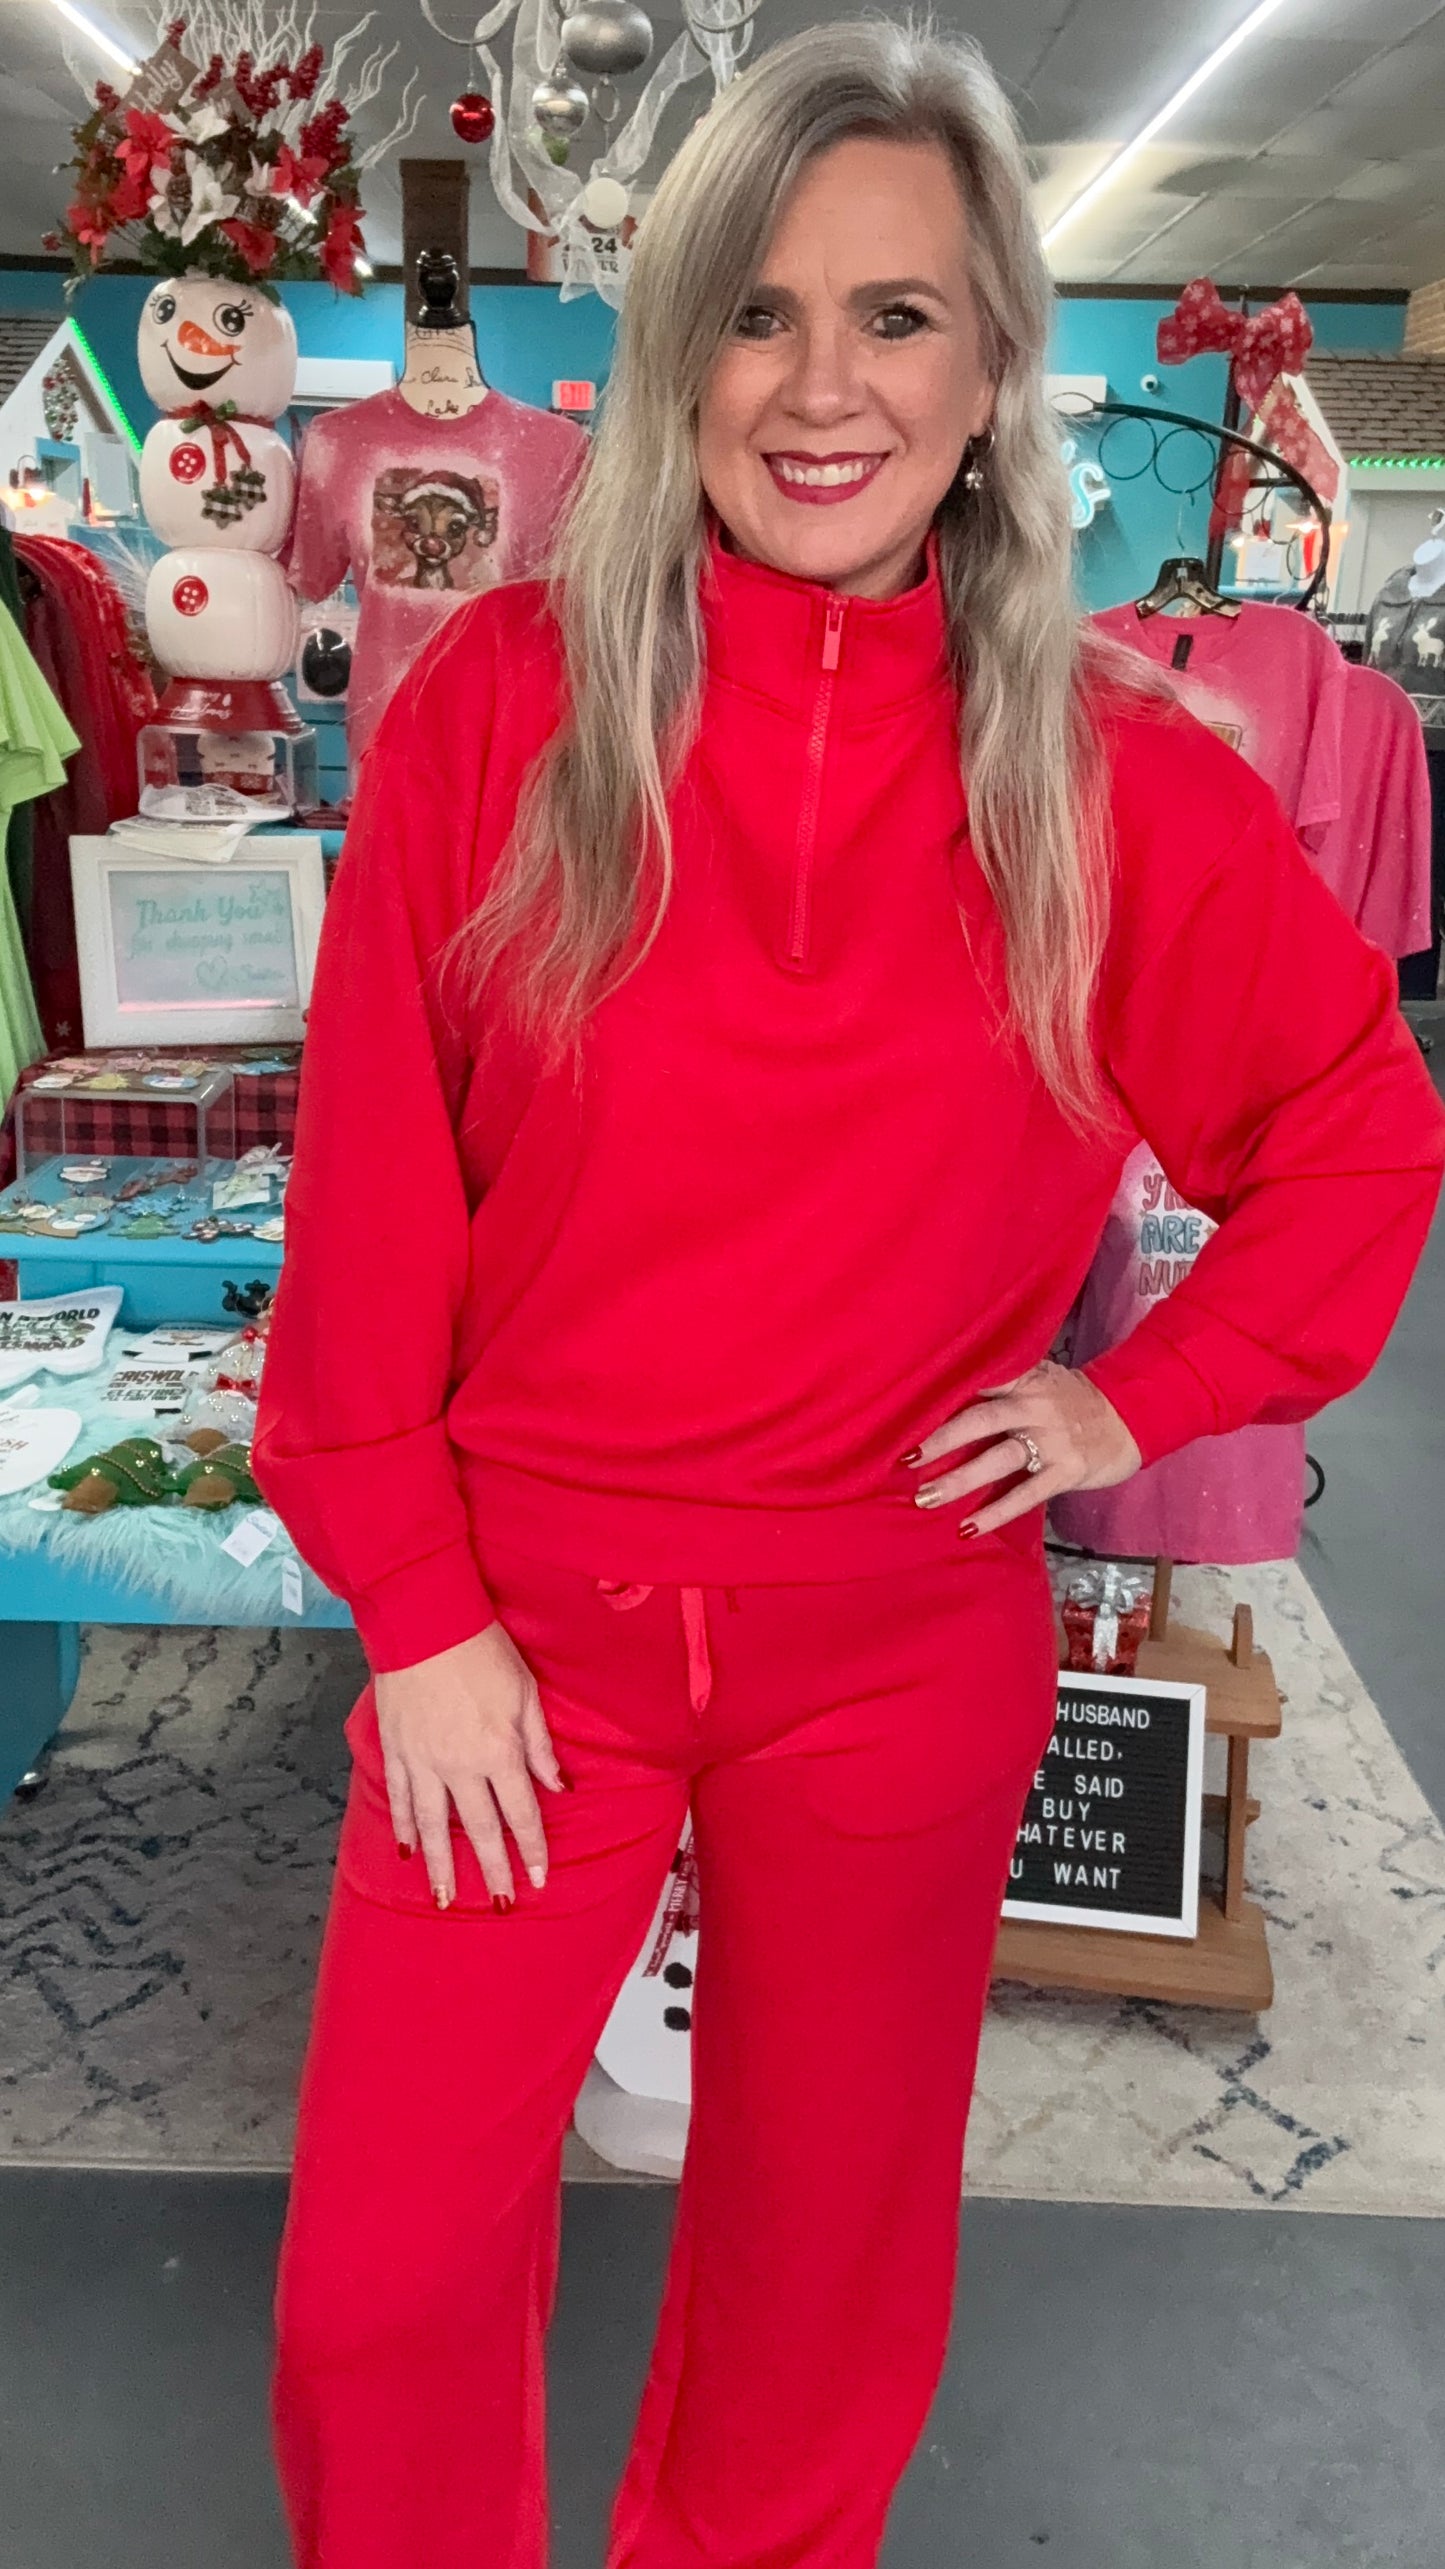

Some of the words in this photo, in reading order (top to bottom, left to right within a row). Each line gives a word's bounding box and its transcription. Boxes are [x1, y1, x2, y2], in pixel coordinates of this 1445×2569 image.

[136, 898, 208, 929] Thank
[217, 895, 263, 926] You
[1140, 1214, 1202, 1254] ARE
[1056, 1701, 1151, 1730] HUSBAND
[1047, 1735, 1123, 1762] ALLED,
[1034, 1770, 1046, 1790] E
[1075, 1774, 1124, 1799] SAID
[1042, 1798, 1091, 1822] BUY
[1016, 1823, 1126, 1855] HATEVER
[1054, 1861, 1121, 1890] WANT
